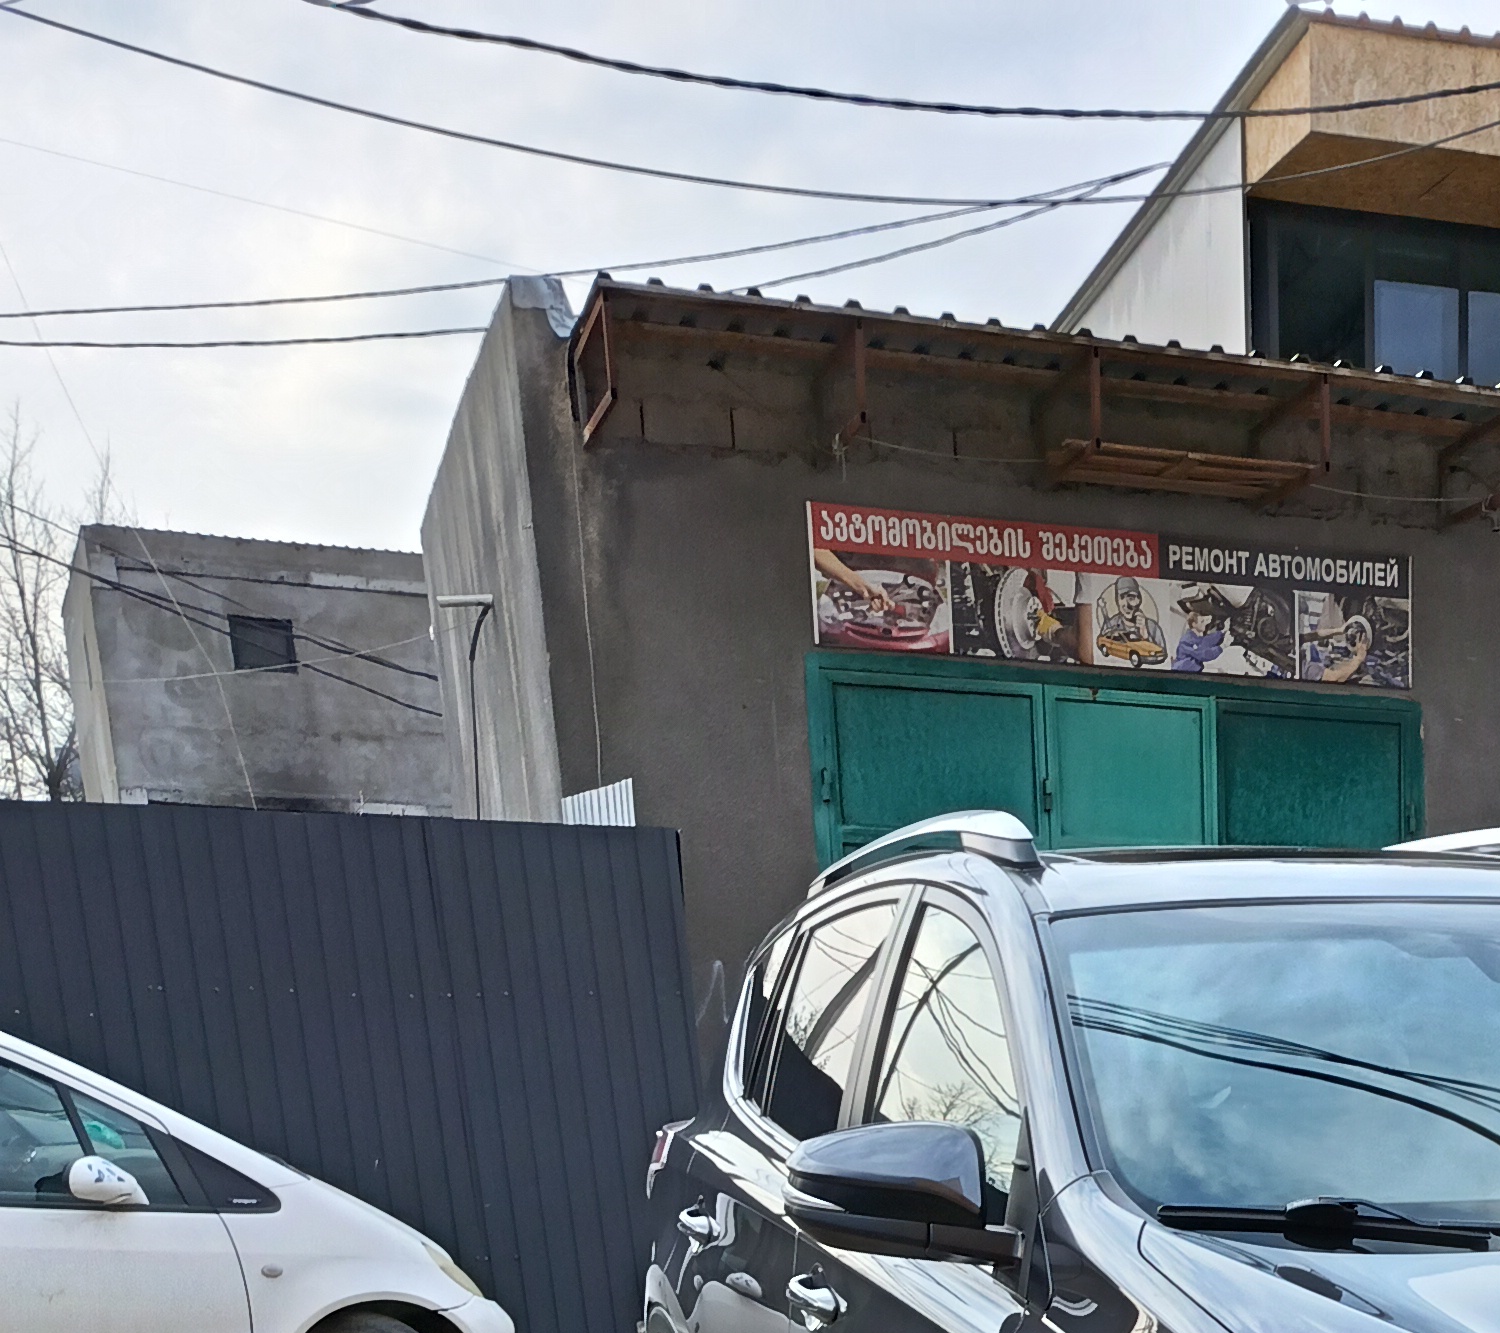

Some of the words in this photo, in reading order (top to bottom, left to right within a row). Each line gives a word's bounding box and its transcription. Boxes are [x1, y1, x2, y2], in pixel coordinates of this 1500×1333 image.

[820, 510, 1031, 559] ავტომობილების
[1039, 531, 1152, 569] შეკეთება
[1168, 544, 1249, 576] РЕМОНТ
[1253, 552, 1398, 588] АВТОМОБИЛЕЙ
